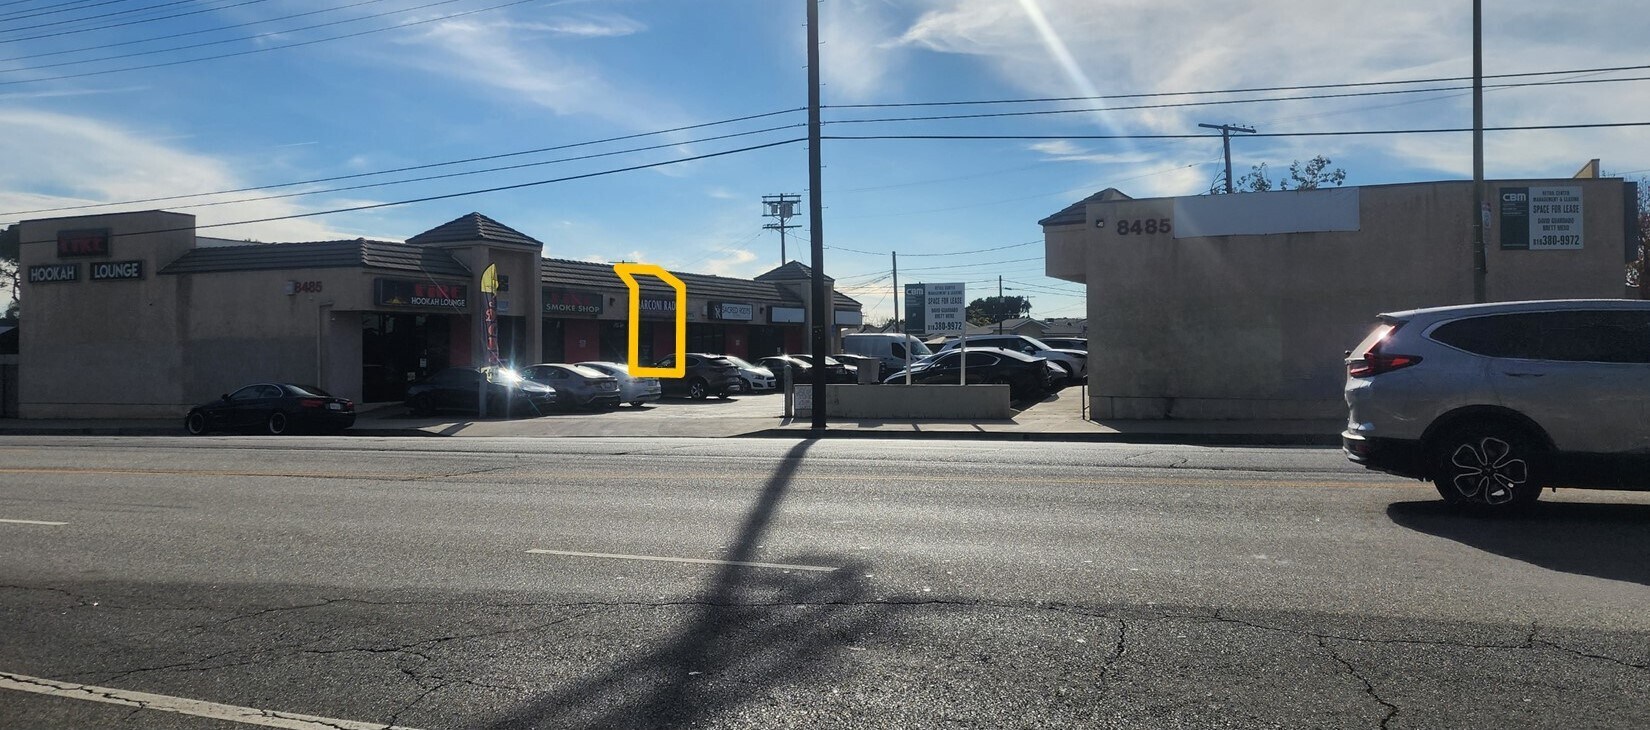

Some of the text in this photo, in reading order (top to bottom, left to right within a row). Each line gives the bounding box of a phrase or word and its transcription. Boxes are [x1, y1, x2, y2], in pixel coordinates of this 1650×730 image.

[1502, 193, 1526, 202] CBM
[1533, 204, 1549, 214] SPACE
[1551, 204, 1561, 214] FOR
[1563, 204, 1580, 214] LEASE
[1116, 218, 1172, 236] 8485
[31, 263, 139, 281] HOOKAH LOUNGE
[294, 281, 322, 294] 8485
[411, 297, 465, 307] HOOKAH LOUNGE
[639, 299, 663, 310] ARCONI
[928, 297, 940, 305] SPACE
[941, 297, 949, 305] FOR
[949, 297, 962, 305] LEASE
[546, 303, 600, 313] SMOKE SHOP
